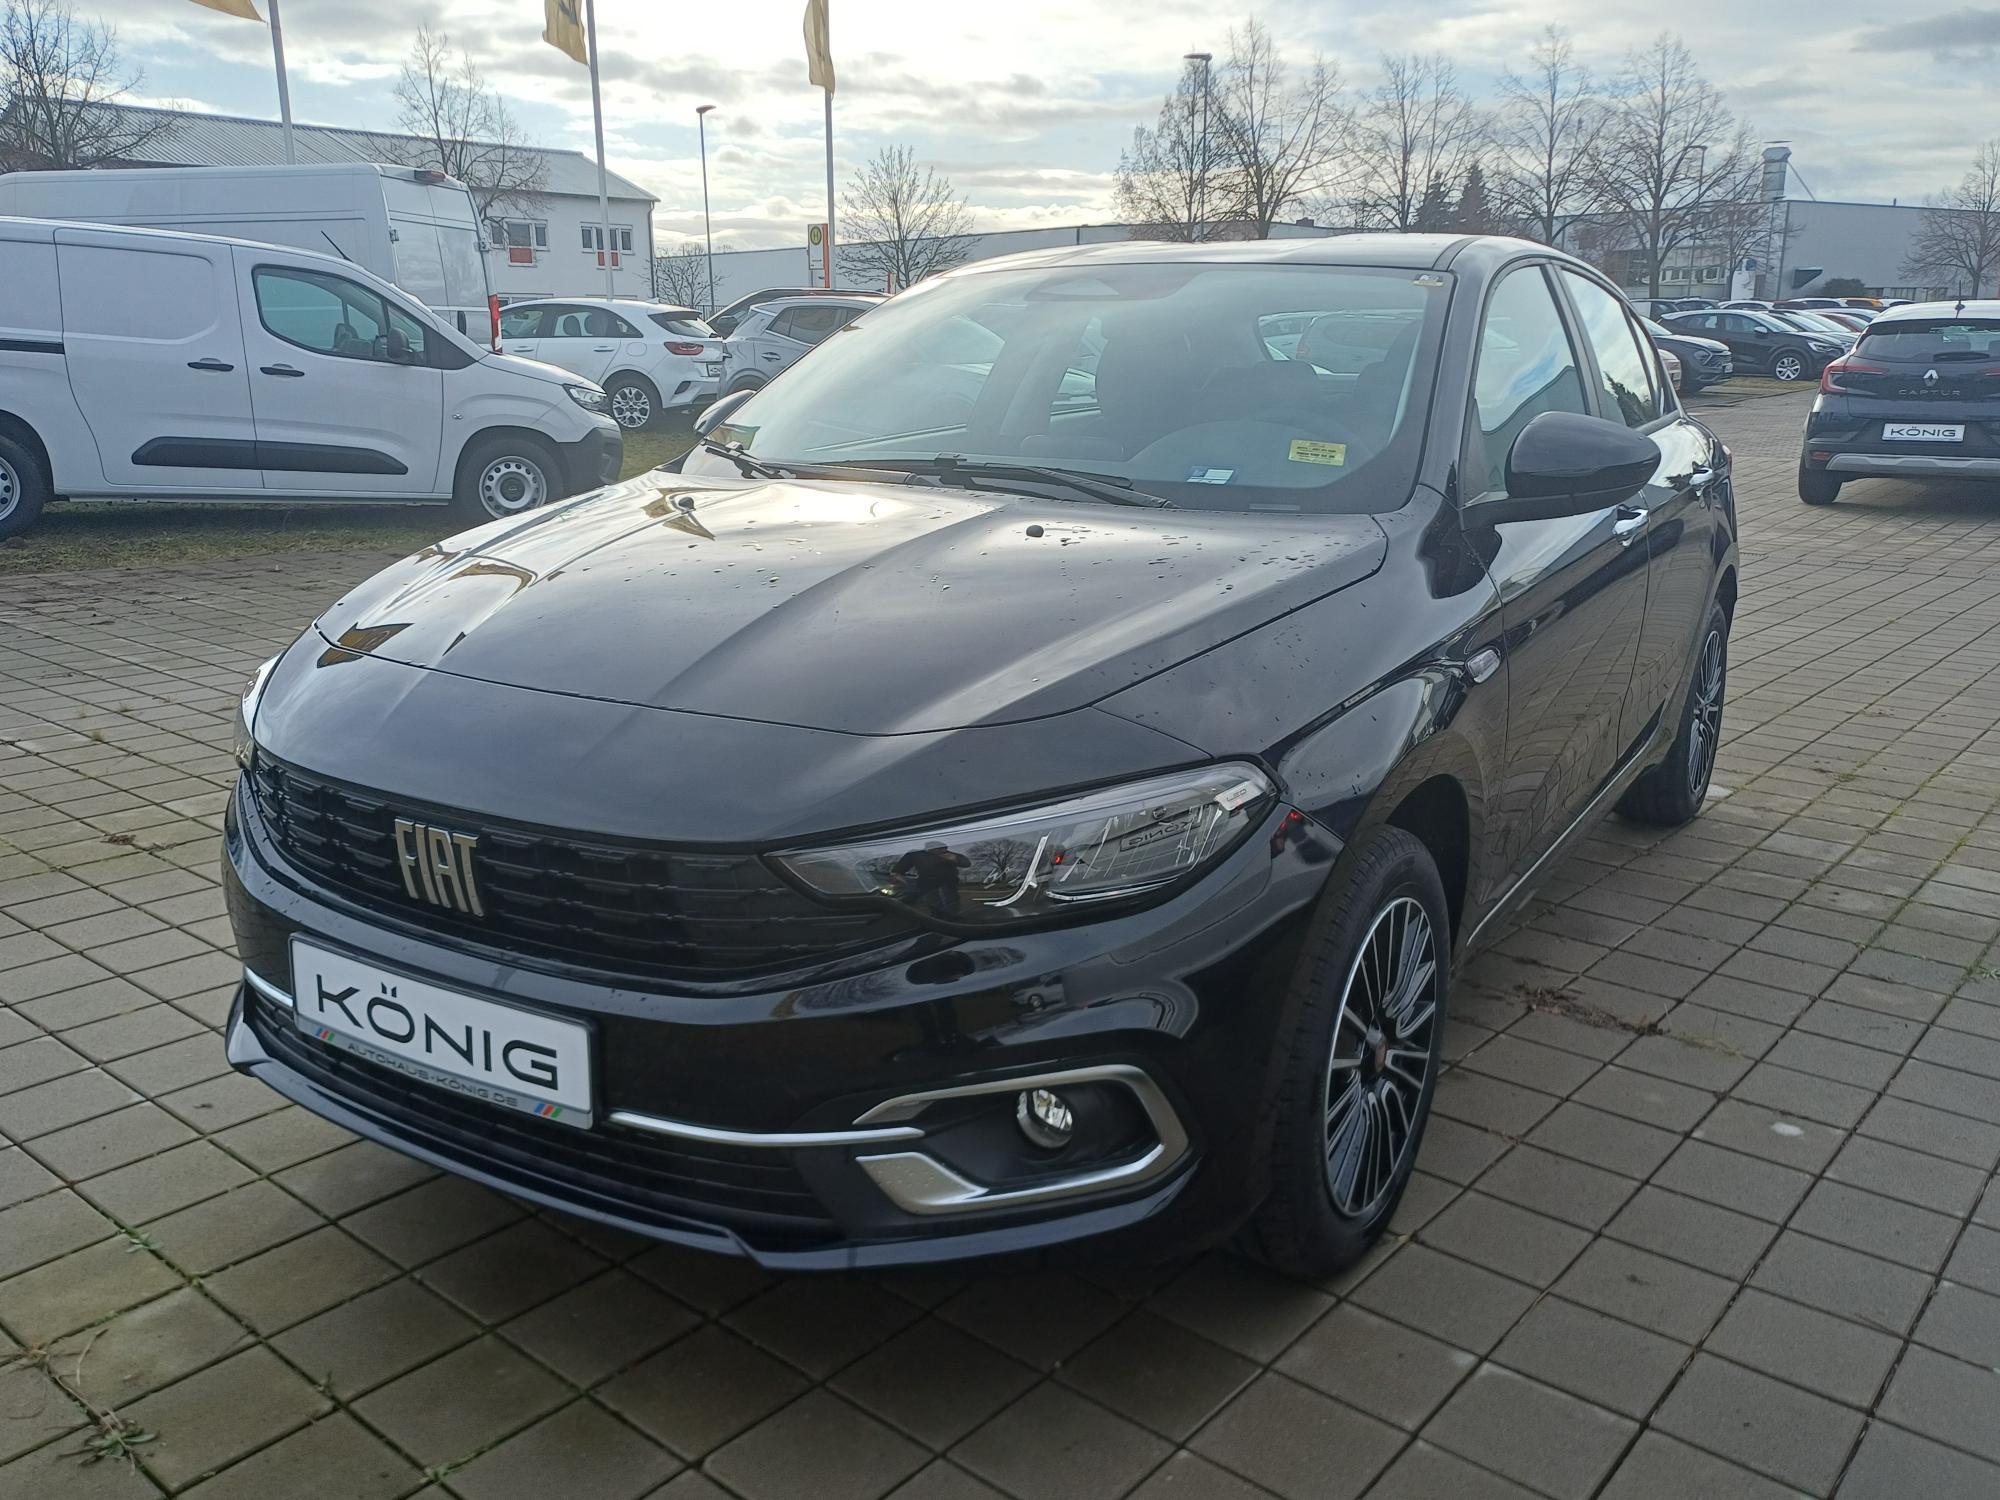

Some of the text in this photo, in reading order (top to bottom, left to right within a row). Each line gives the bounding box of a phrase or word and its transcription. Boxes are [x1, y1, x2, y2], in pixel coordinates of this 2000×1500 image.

[1898, 389, 1961, 397] CAPTUR
[1890, 425, 1956, 438] KÖNIG
[394, 816, 484, 918] FIAT
[316, 974, 559, 1091] KÖNIG
